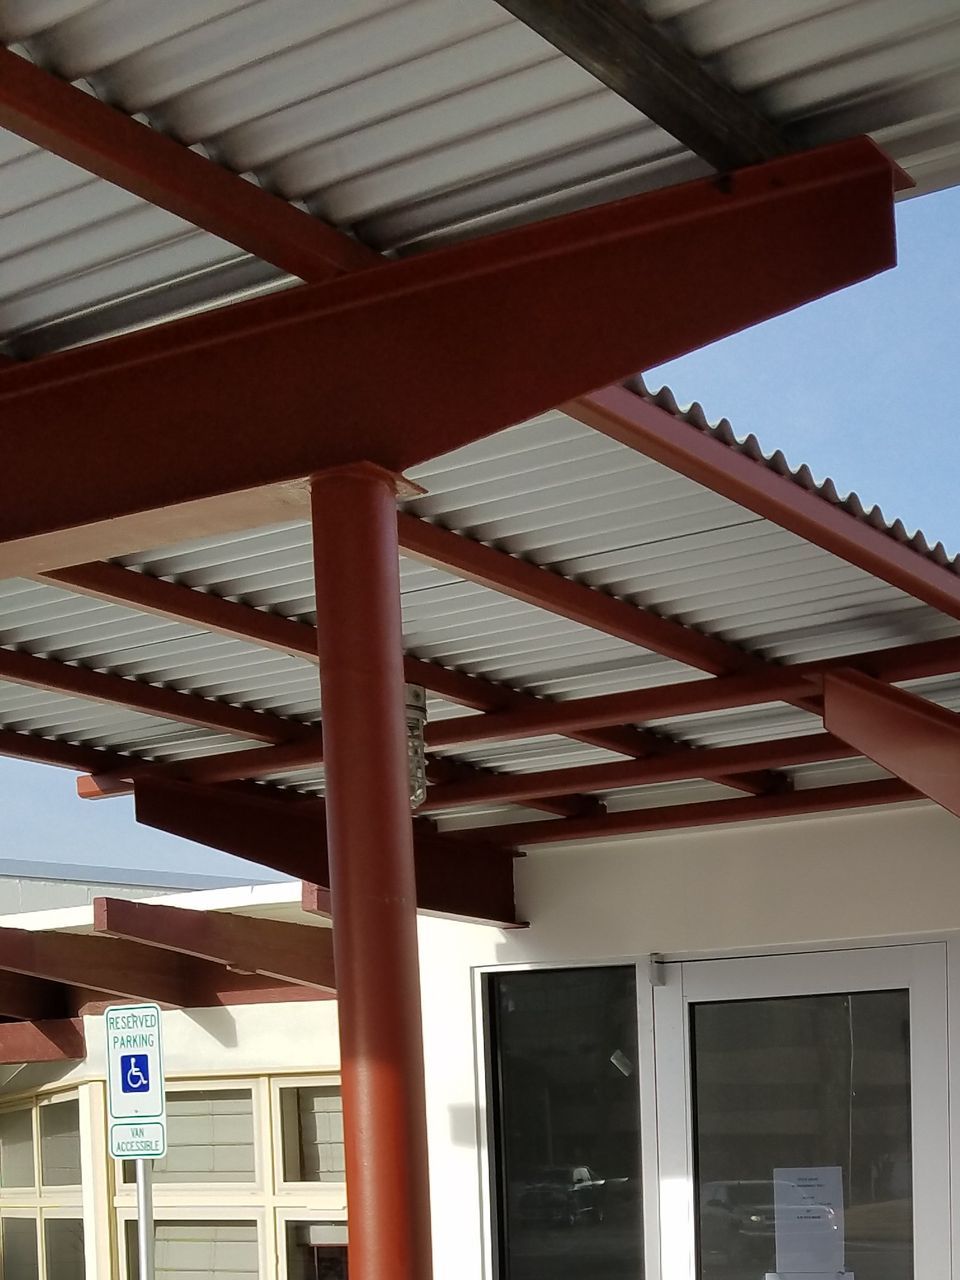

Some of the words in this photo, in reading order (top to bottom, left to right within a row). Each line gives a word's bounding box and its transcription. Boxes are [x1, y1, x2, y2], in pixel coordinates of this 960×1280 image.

[109, 1014, 156, 1030] RESERVED
[113, 1034, 154, 1050] PARKING
[130, 1127, 145, 1139] VAN
[116, 1140, 160, 1152] ACCESSIBLE
